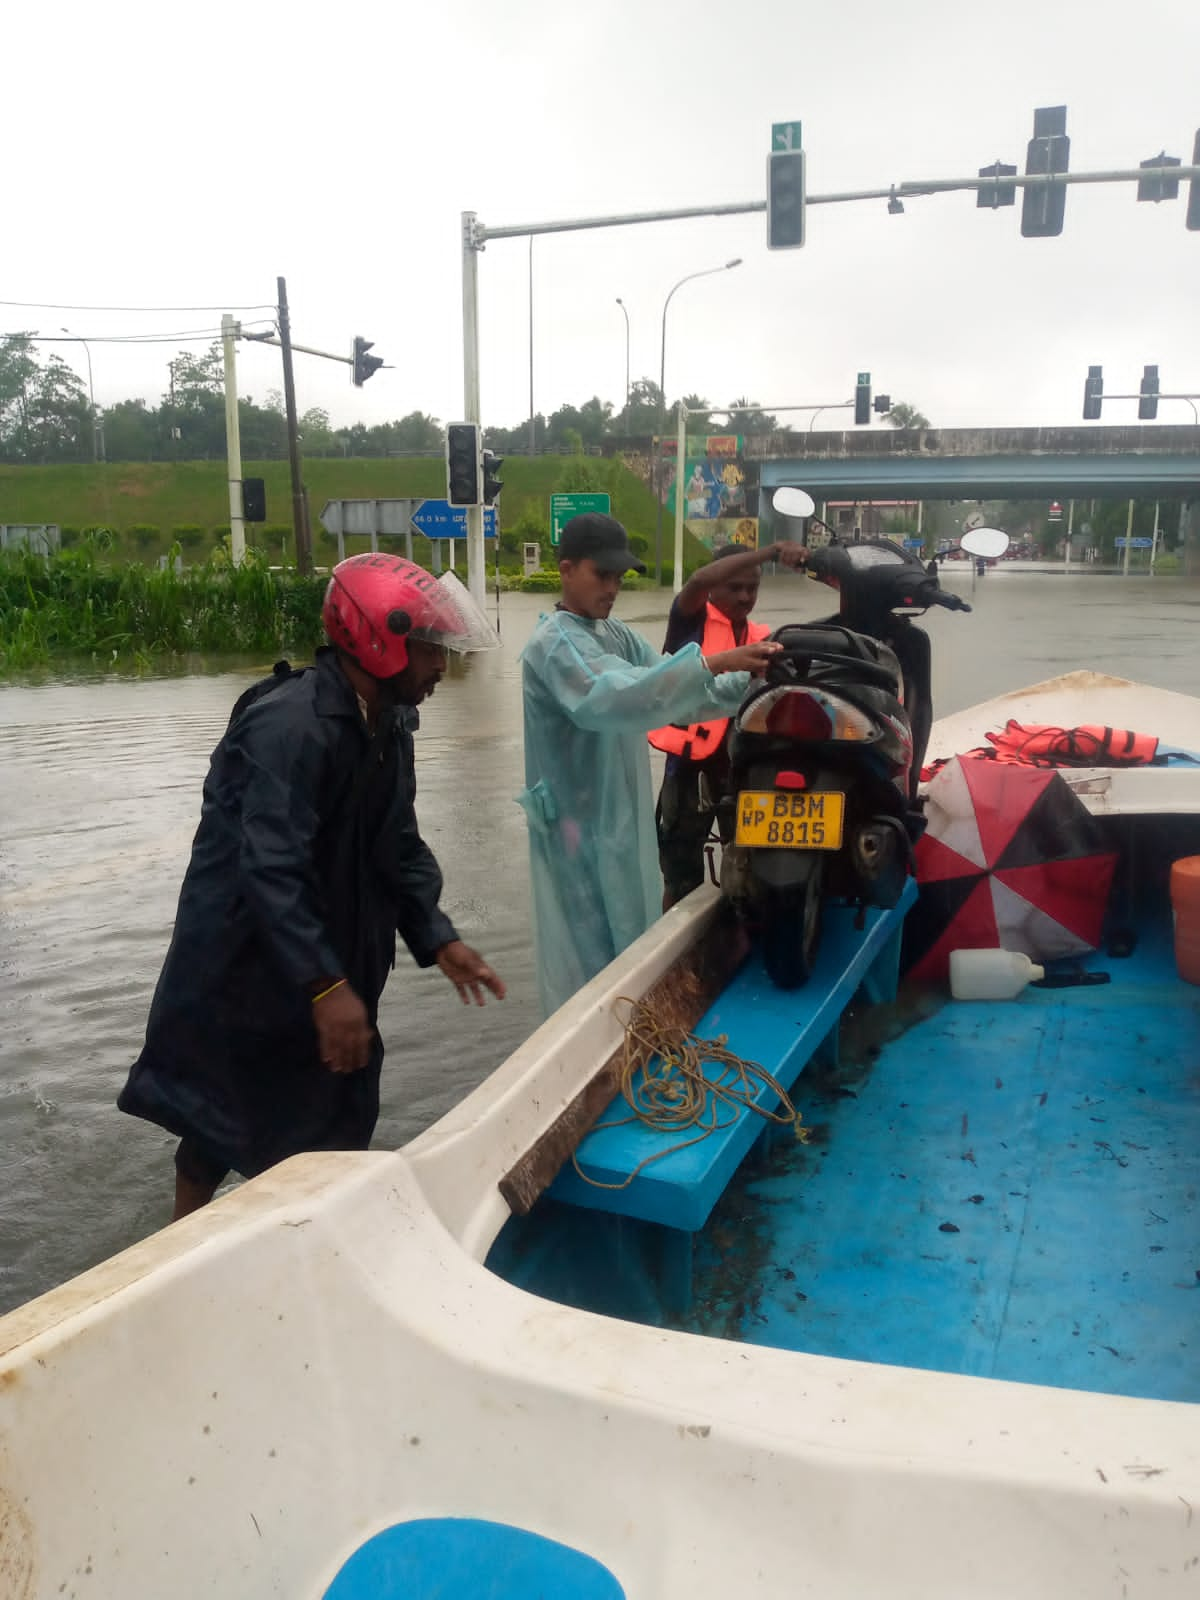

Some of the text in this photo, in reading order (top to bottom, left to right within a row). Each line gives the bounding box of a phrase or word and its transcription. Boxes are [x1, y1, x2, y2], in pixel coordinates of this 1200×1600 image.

[773, 794, 824, 818] BBM
[742, 811, 765, 827] WP
[767, 821, 824, 844] 8815
